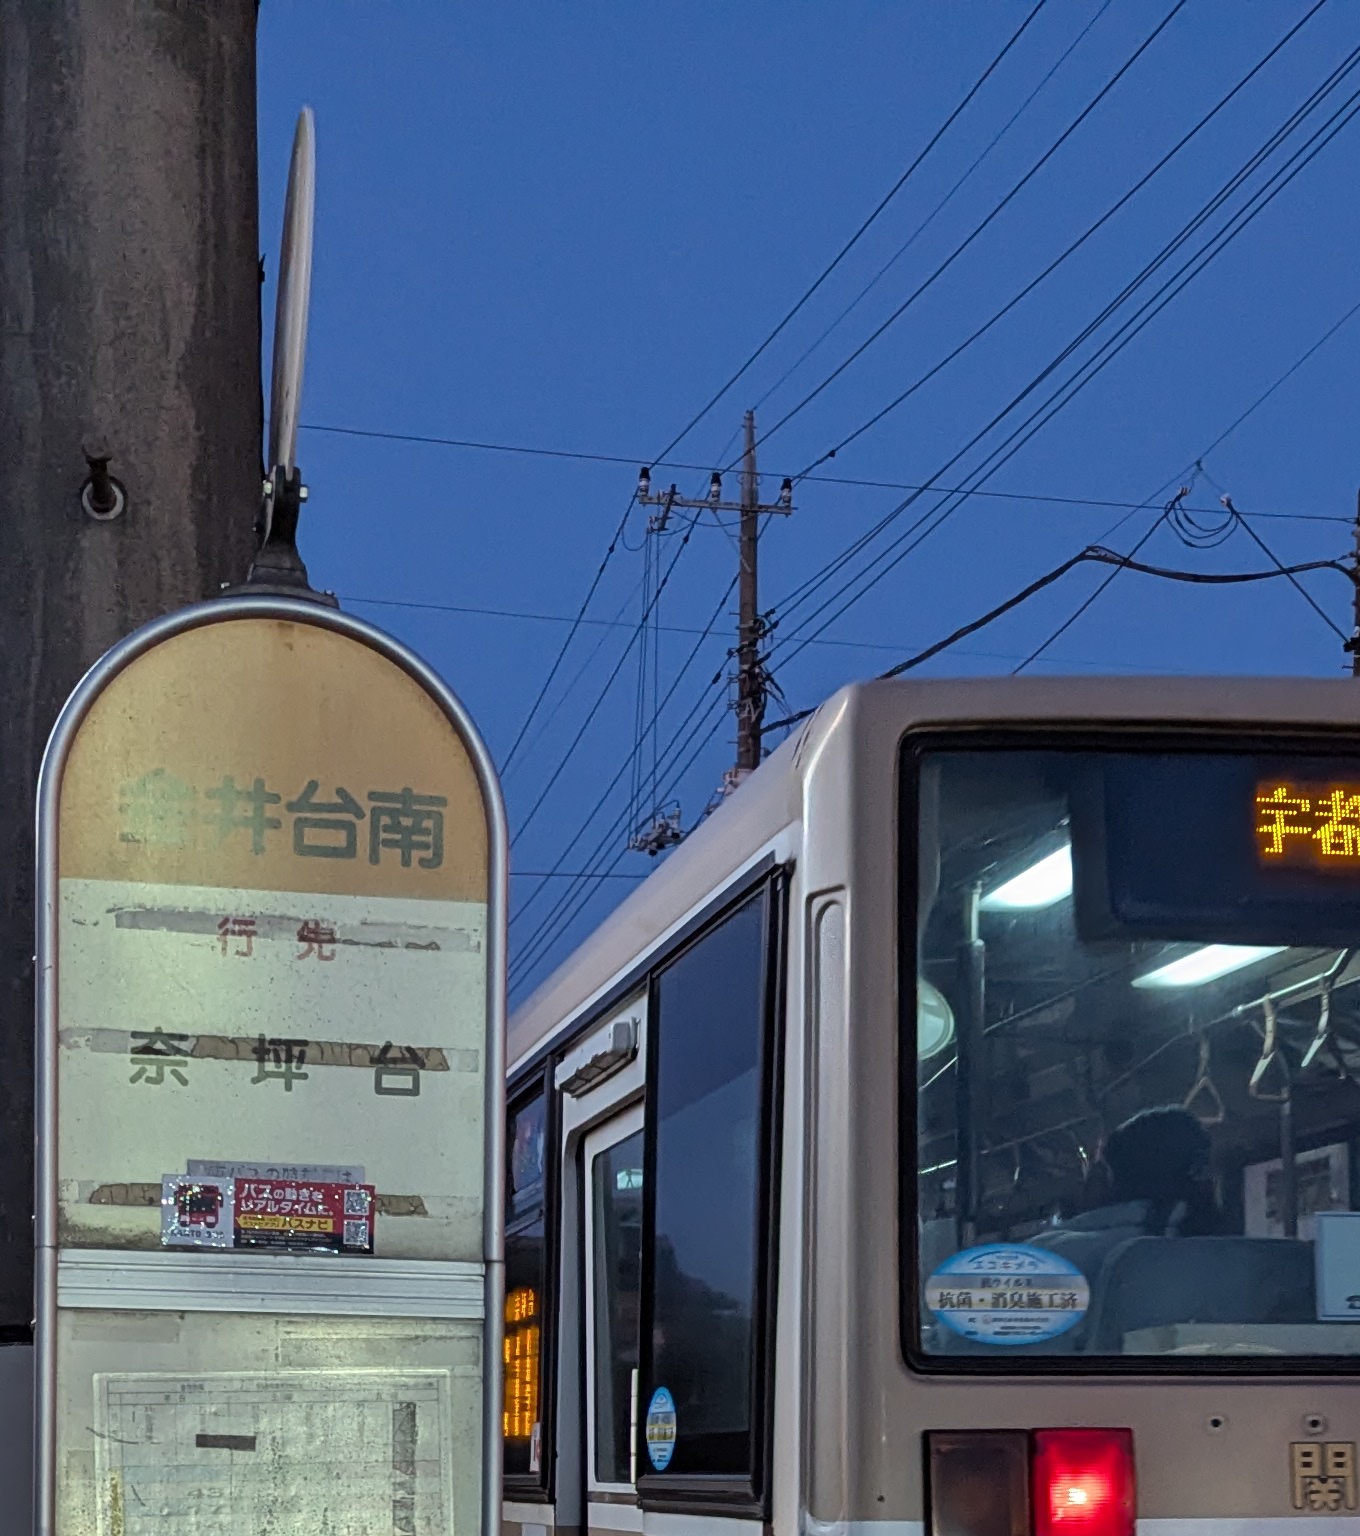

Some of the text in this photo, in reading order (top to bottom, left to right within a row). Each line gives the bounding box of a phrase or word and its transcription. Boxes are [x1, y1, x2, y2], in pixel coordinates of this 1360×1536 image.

[216, 917, 337, 962] 行先
[129, 1026, 426, 1097] 奈坪台
[281, 1217, 329, 1231] バスナビ
[938, 1291, 1078, 1309] 抗菌・消臭施工済
